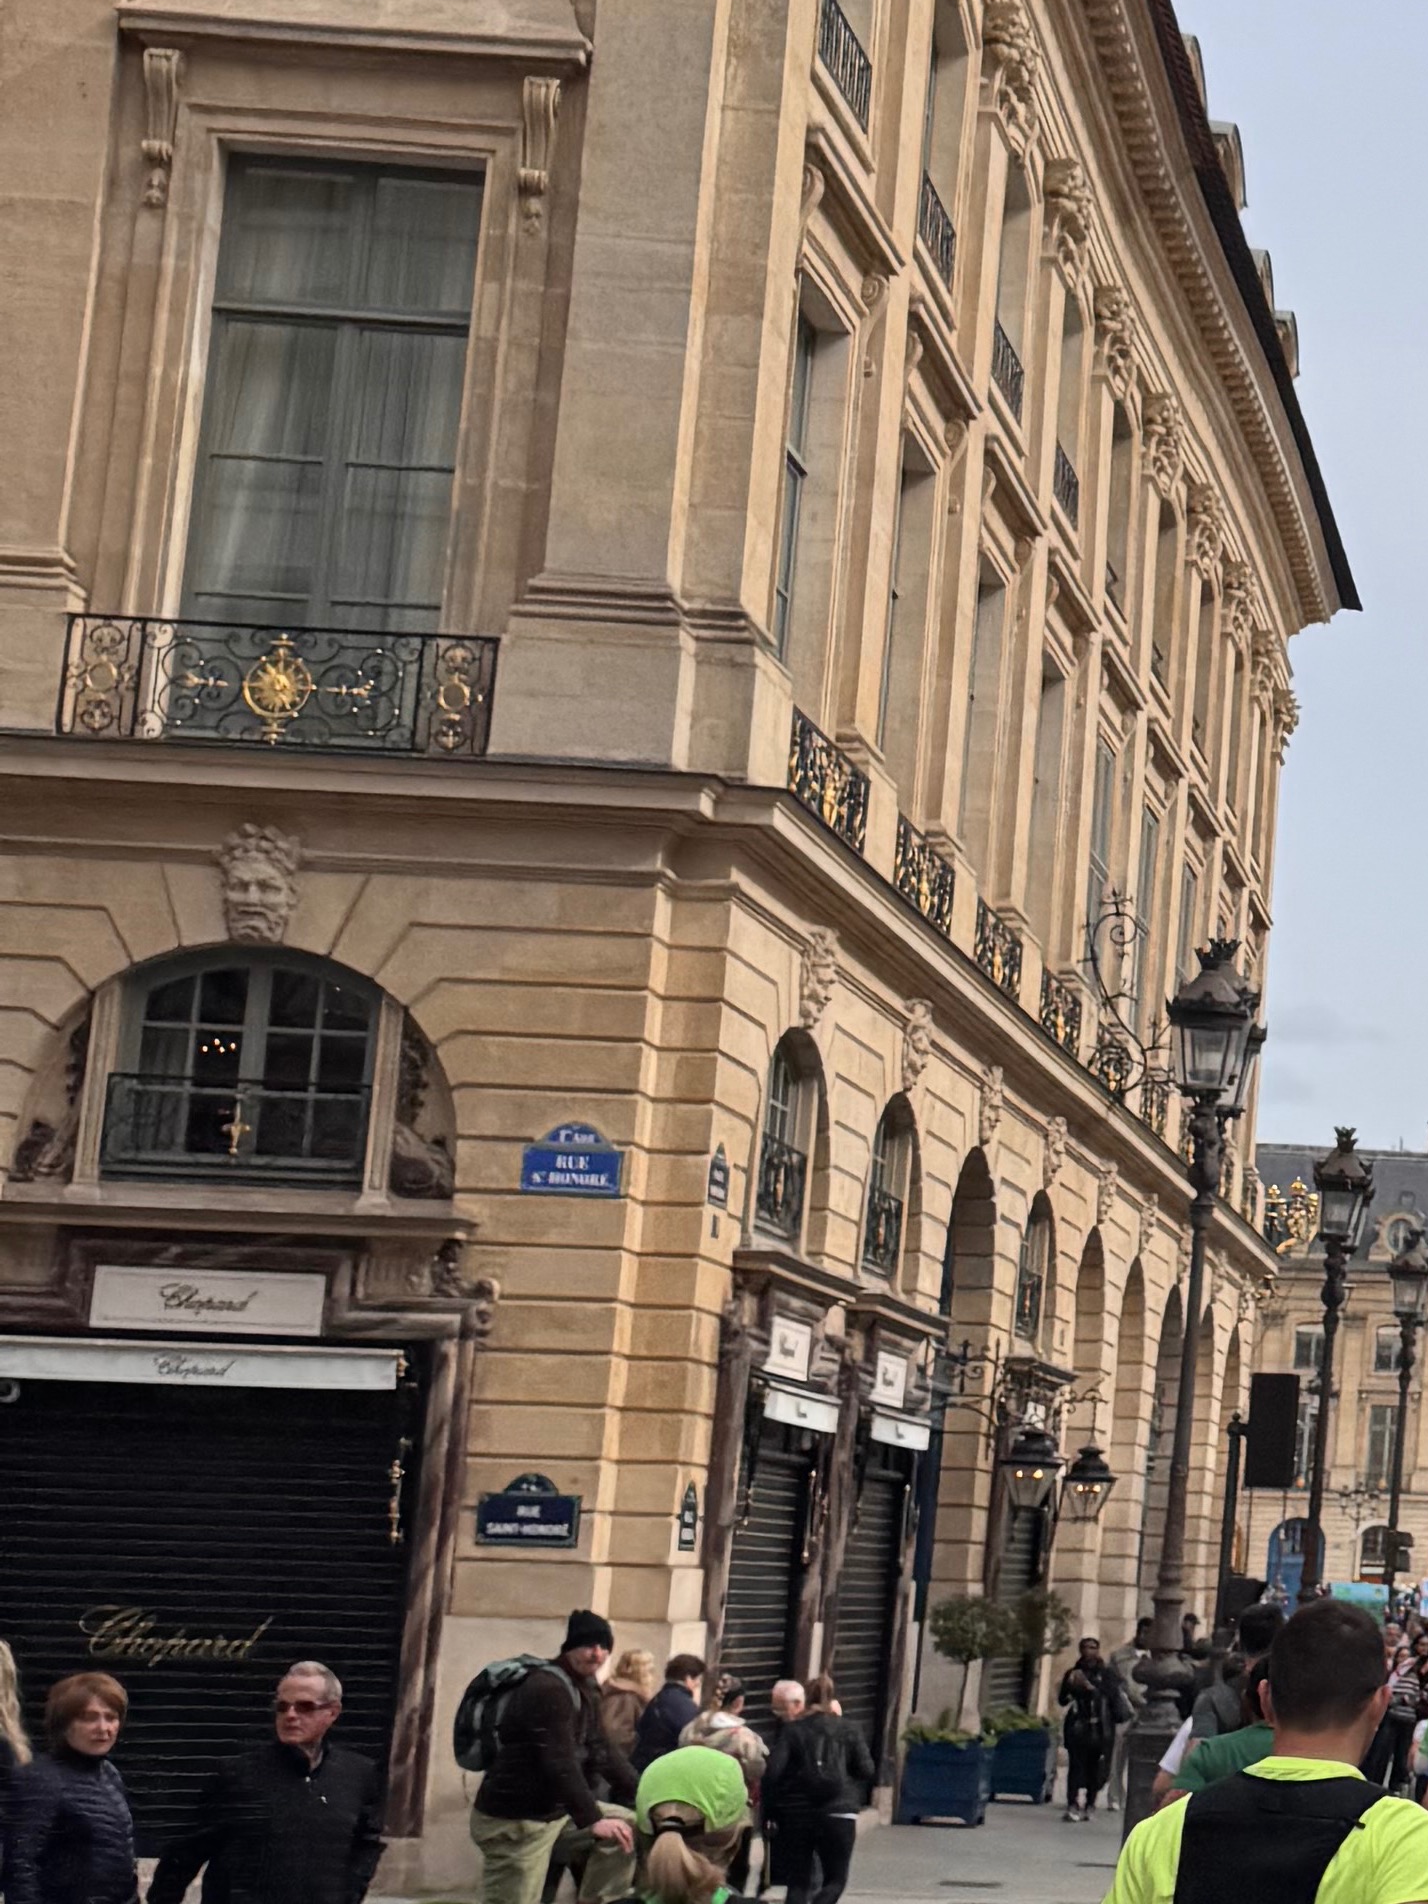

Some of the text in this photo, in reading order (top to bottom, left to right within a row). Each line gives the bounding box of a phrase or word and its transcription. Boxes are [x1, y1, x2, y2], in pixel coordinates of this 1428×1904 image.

[555, 1154, 590, 1170] RUE
[159, 1282, 258, 1316] Chopard
[79, 1604, 274, 1667] Chopard
